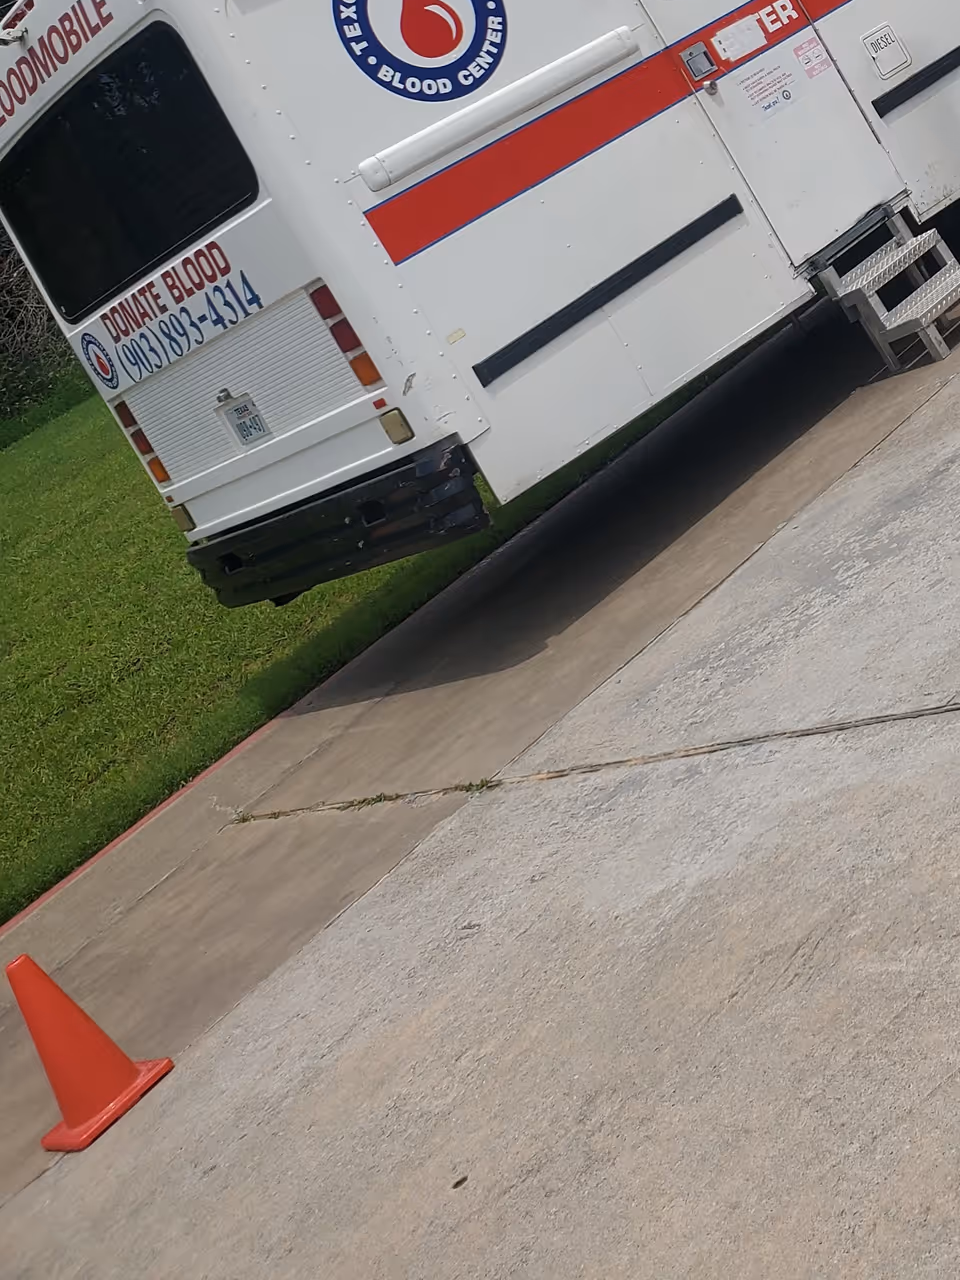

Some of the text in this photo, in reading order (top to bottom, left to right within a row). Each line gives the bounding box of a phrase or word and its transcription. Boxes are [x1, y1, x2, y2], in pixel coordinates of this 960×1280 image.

[377, 15, 503, 95] BLOOD CENTER
[870, 32, 896, 54] DIESEL
[100, 240, 232, 344] DONATE BLOOD
[114, 269, 264, 383] (903)893-4314
